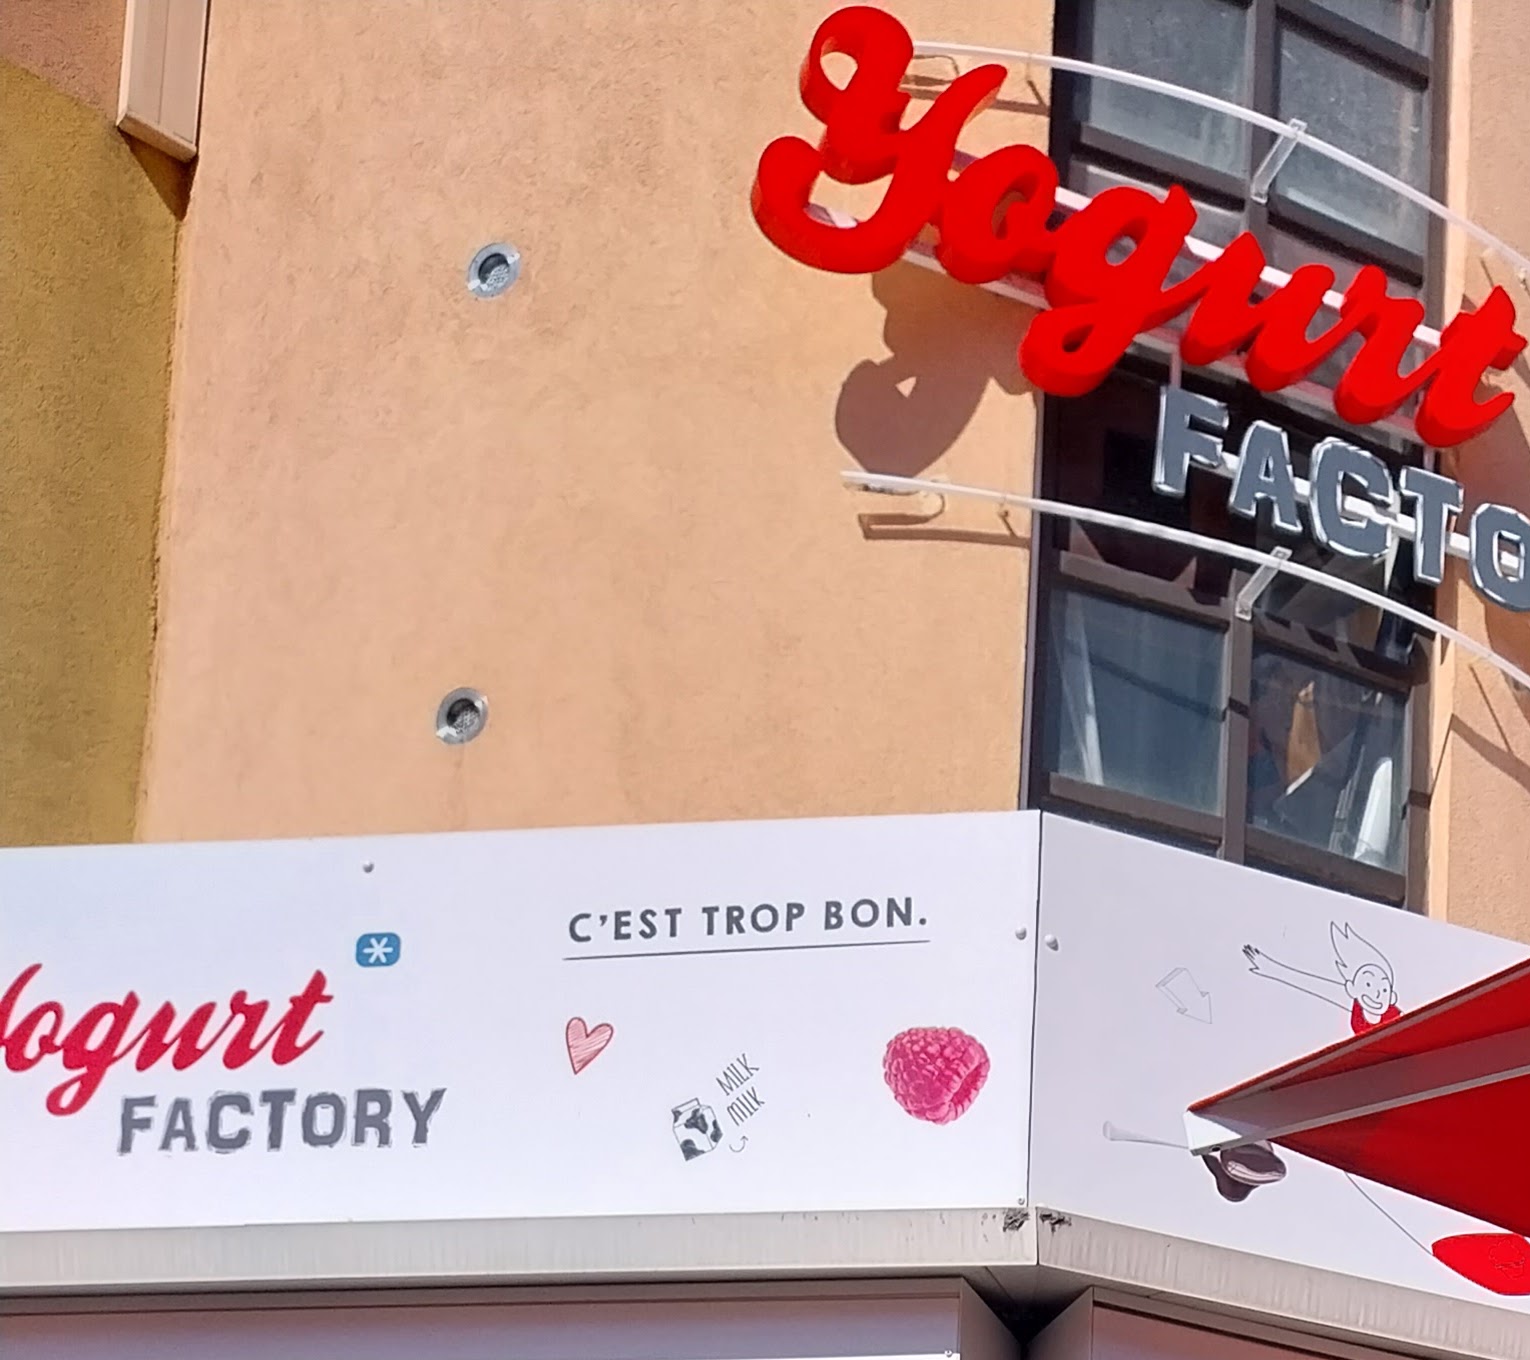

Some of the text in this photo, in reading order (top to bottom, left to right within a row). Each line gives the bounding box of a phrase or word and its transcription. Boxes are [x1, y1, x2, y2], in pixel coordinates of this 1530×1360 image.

[751, 4, 1528, 449] Yogurt
[567, 896, 929, 944] C'EST TROP BON.
[715, 1053, 761, 1096] MILK
[116, 1087, 448, 1157] FACTORY
[726, 1086, 765, 1127] MILK
